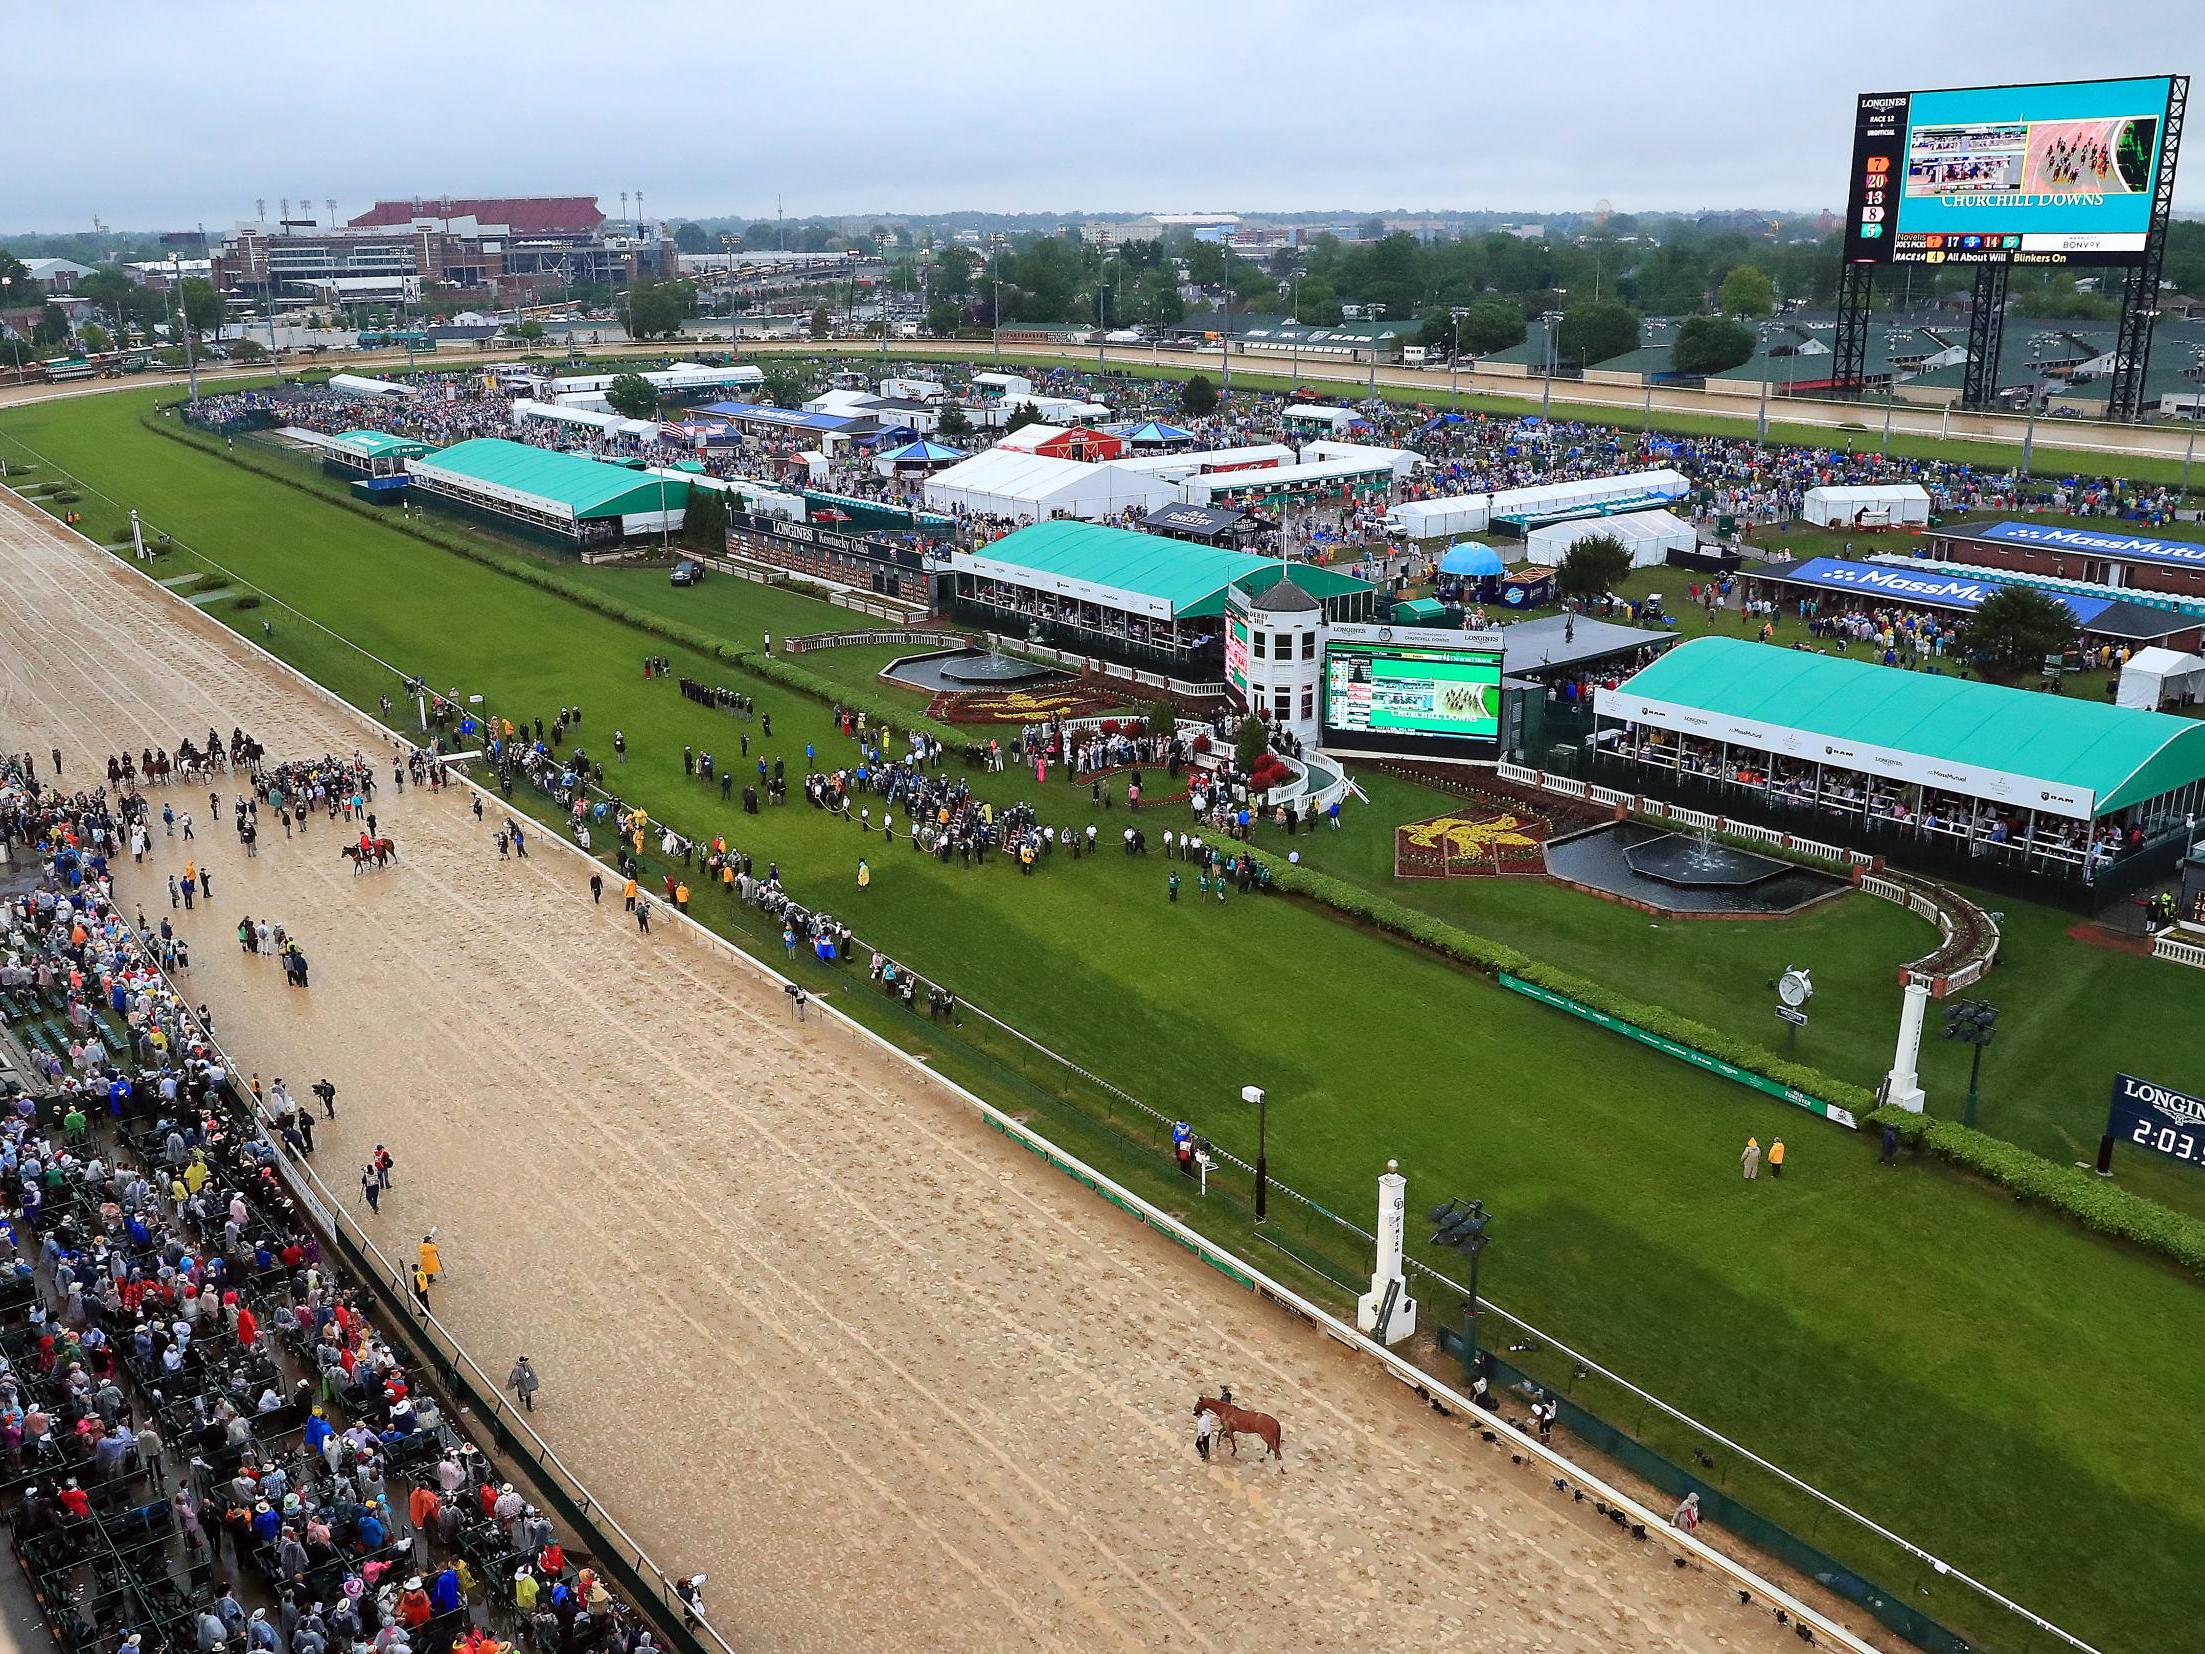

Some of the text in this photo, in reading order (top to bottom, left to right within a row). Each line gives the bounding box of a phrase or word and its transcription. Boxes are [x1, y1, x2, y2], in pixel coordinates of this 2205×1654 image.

[1862, 98, 1906, 108] LONGINES
[1868, 175, 1884, 188] 20
[1867, 191, 1883, 205] 13
[1942, 192, 2104, 207] CHURCHILL DOWNS
[1866, 224, 1875, 237] 5
[1947, 236, 1959, 247] 17
[1986, 236, 1998, 247] 14
[1895, 253, 1916, 261] RACE
[1947, 252, 2066, 263] All About Will Blinkers On
[1165, 512, 1213, 526] FORESTER
[773, 521, 869, 554] LONGINES Kentucky Oaks
[1250, 611, 1268, 620] DERBY
[1833, 748, 1854, 757] RAM
[1933, 770, 1967, 783] MassMutual
[2050, 795, 2074, 803] RAM
[2133, 1119, 2205, 1166] 2:03.
